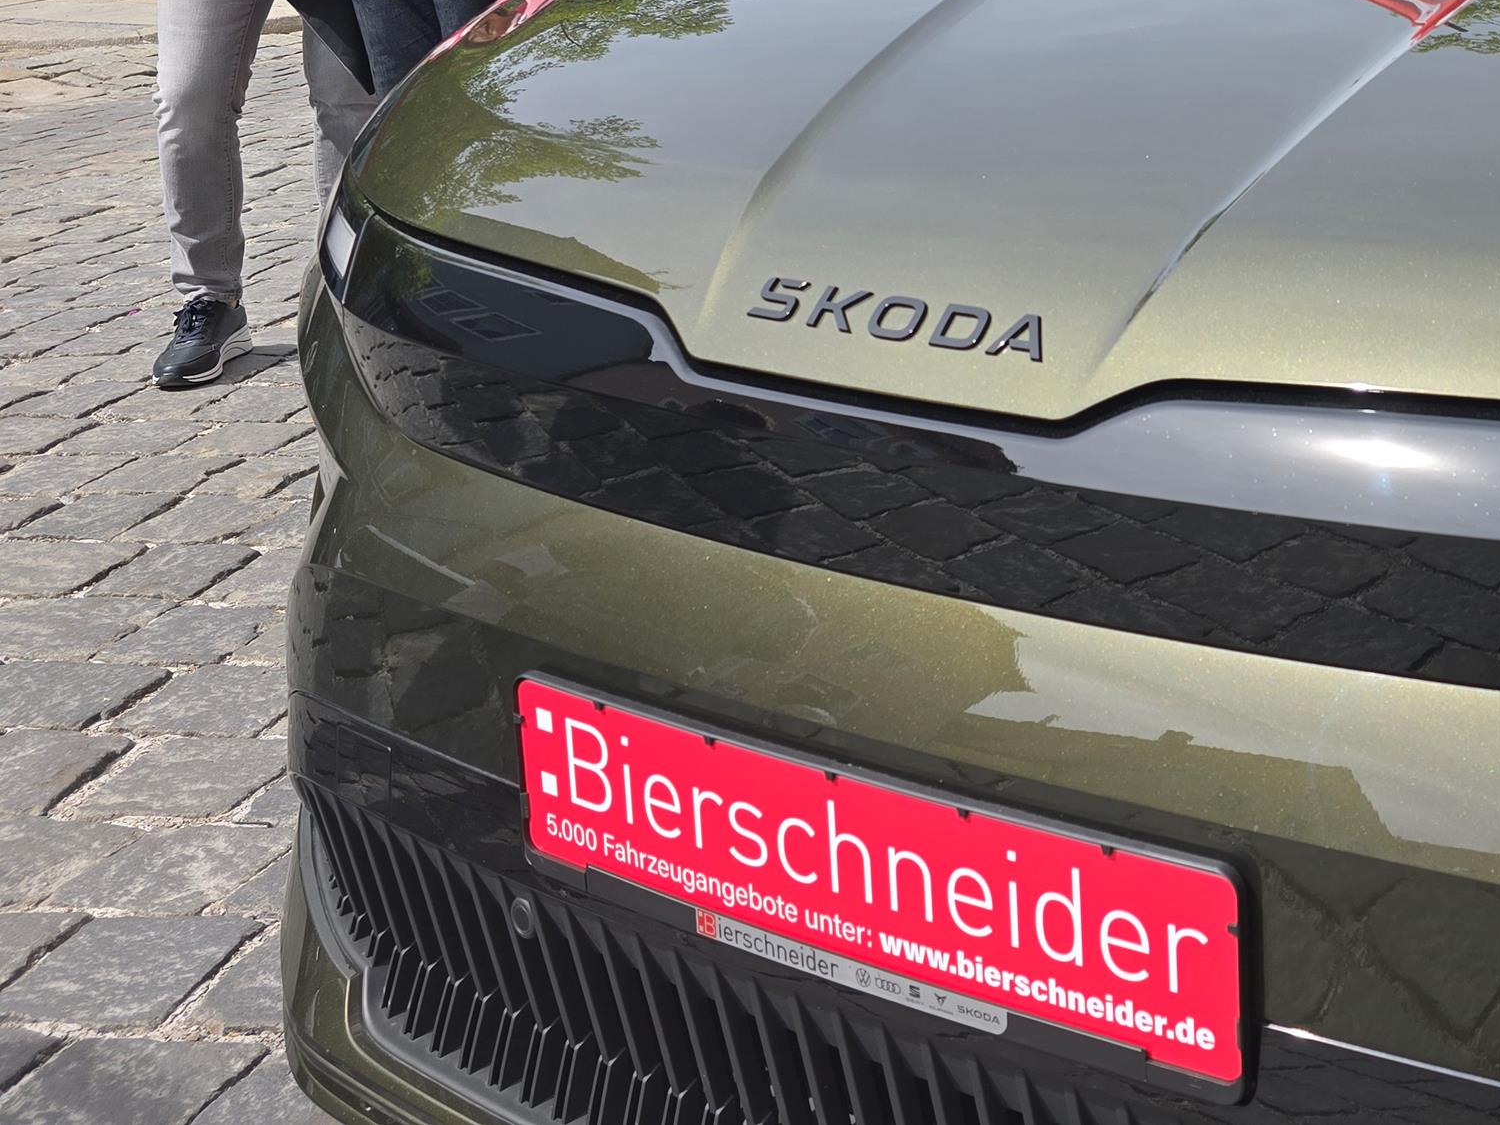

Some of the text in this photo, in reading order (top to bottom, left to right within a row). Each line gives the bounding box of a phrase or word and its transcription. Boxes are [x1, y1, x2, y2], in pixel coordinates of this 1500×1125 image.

[546, 813, 1216, 1050] 5.000 Fahrzeugangebote unter: www.bierschneider.de
[564, 717, 1209, 994] Bierschneider
[703, 914, 839, 978] Bierschneider
